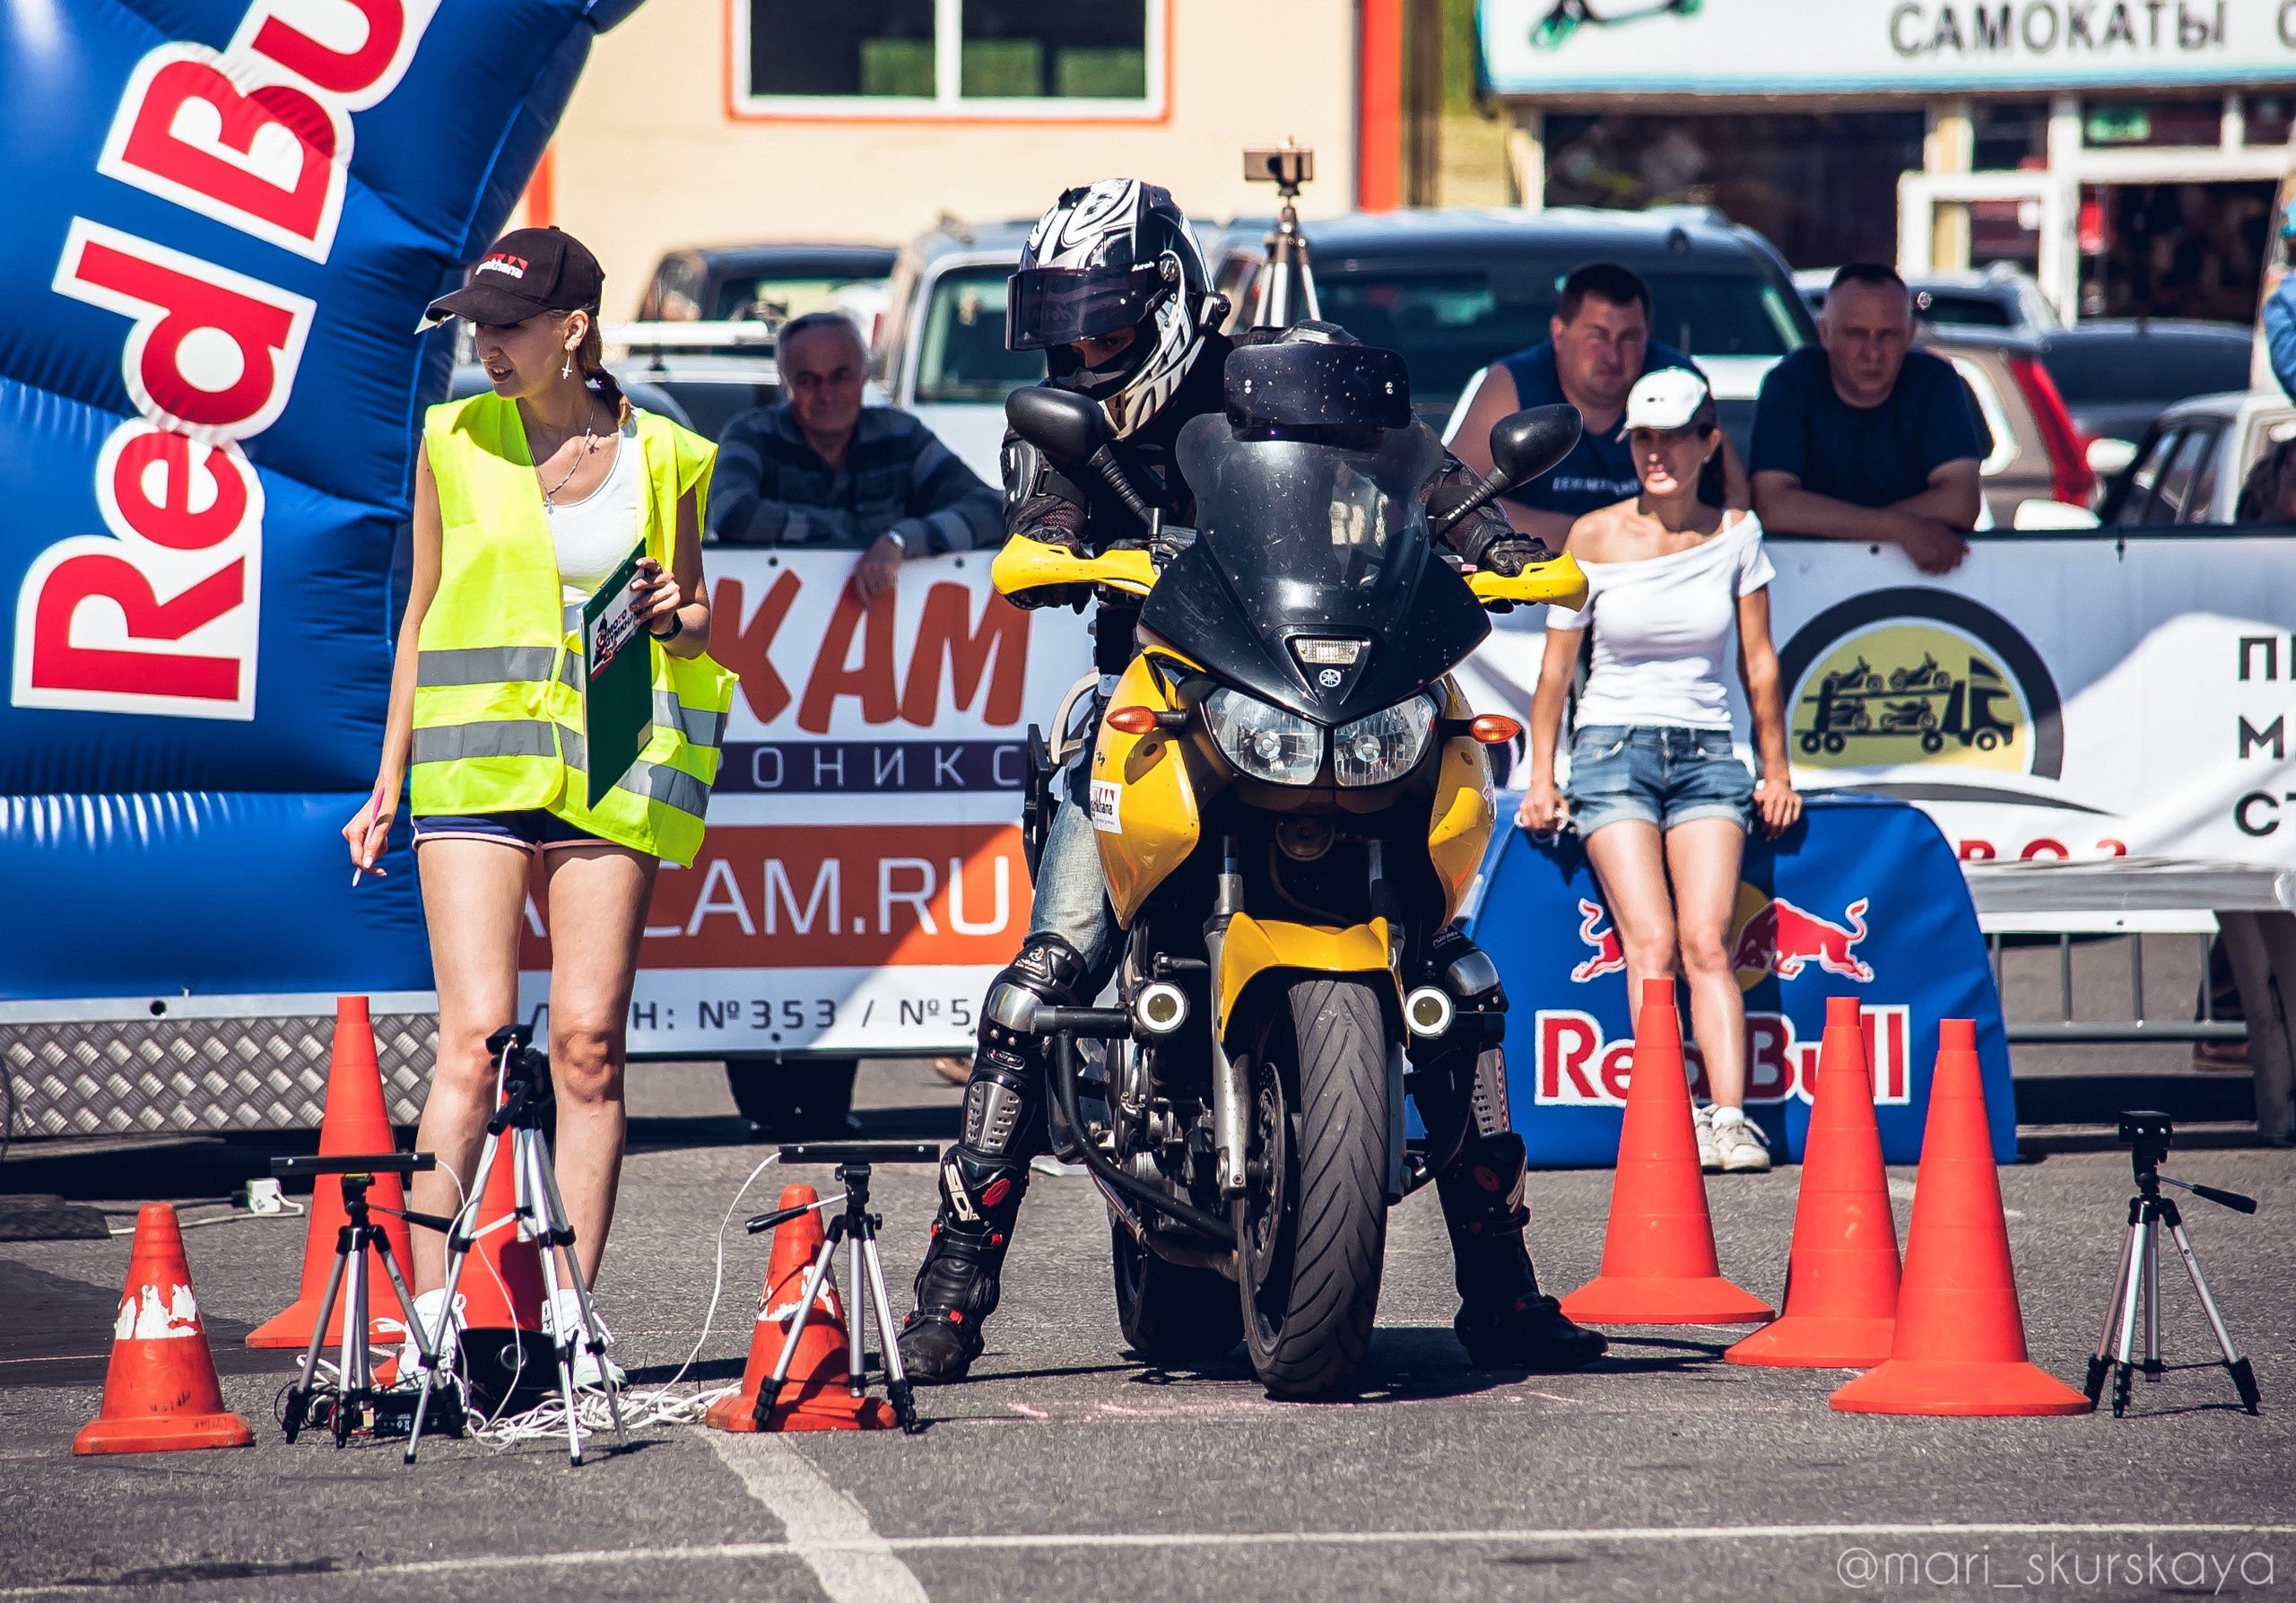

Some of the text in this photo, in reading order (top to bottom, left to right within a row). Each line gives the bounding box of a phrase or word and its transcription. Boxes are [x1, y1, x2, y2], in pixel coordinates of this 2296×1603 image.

[1890, 1, 2225, 56] САМОКАТЫ
[31, 240, 294, 702] Red
[2239, 636, 2296, 681] П
[718, 746, 1021, 788] ОНИКС
